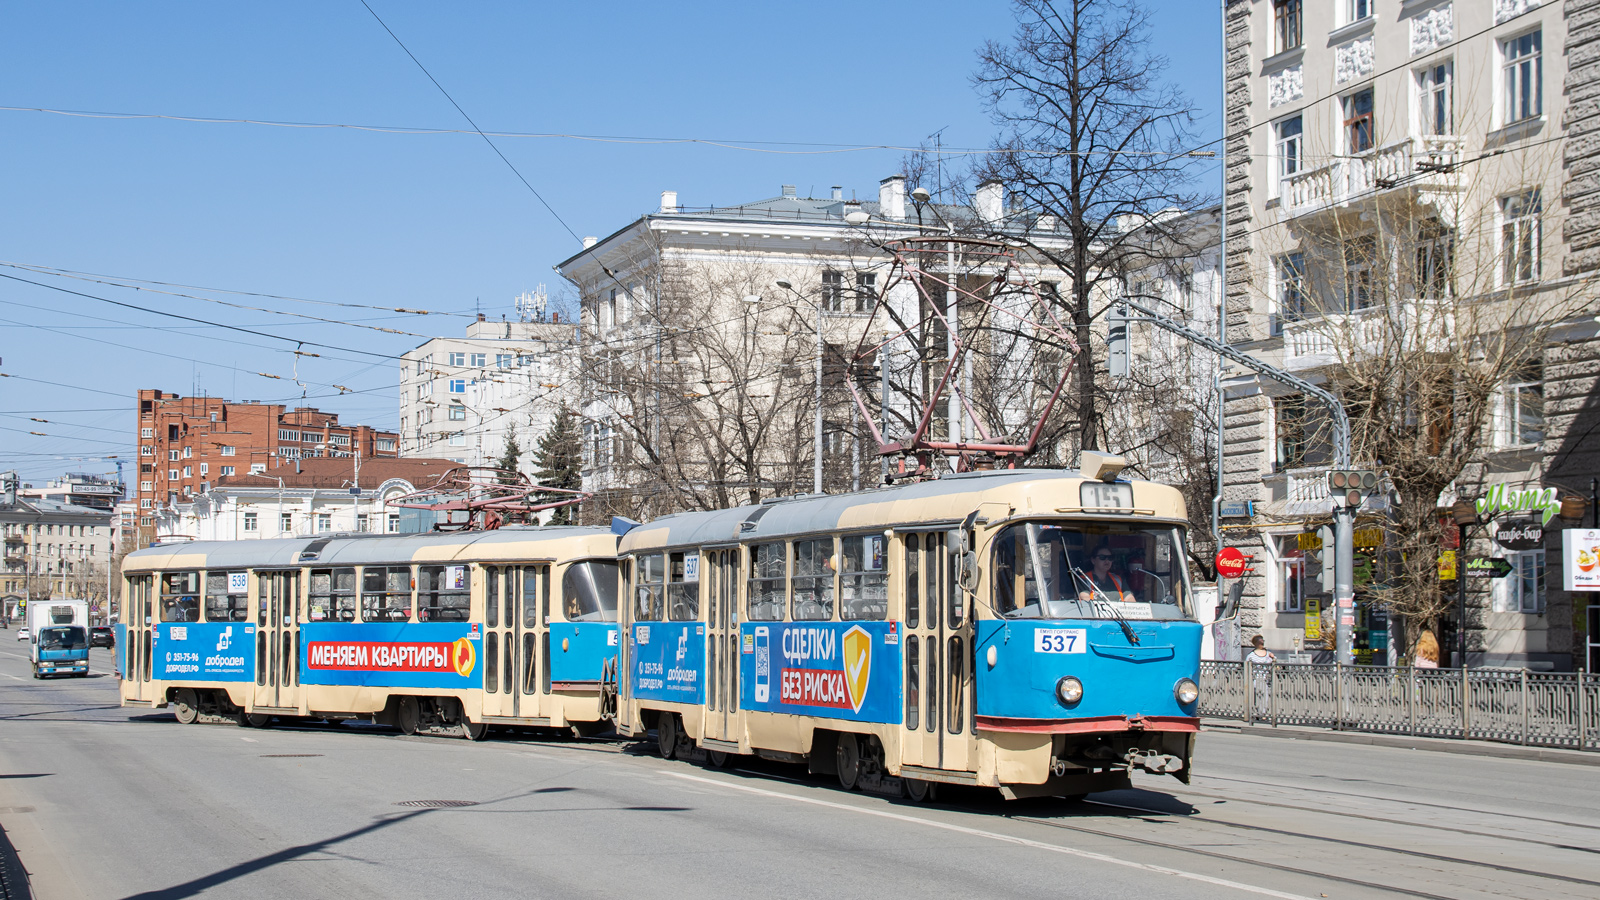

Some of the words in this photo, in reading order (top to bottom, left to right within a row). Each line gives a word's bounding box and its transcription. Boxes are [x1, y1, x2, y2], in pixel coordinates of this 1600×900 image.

[1090, 487, 1121, 513] 15
[1475, 482, 1558, 515] Мята
[1497, 526, 1542, 543] кафе-бар
[686, 557, 698, 575] 537
[232, 574, 247, 587] 538
[782, 628, 836, 665] СДЕЛКИ
[1041, 635, 1077, 652] 537
[173, 653, 199, 662] 351-75-96
[205, 654, 245, 667] добродел
[311, 645, 368, 666] МЕНЯЕМ
[372, 646, 448, 668] КВАРТИРЫ
[165, 664, 200, 673] ДОБРОДЕЛ.РФ
[644, 662, 664, 675] 351-75-96
[667, 665, 697, 683] добродел
[782, 671, 802, 700] БЕЗ
[804, 672, 846, 704] РИСКА
